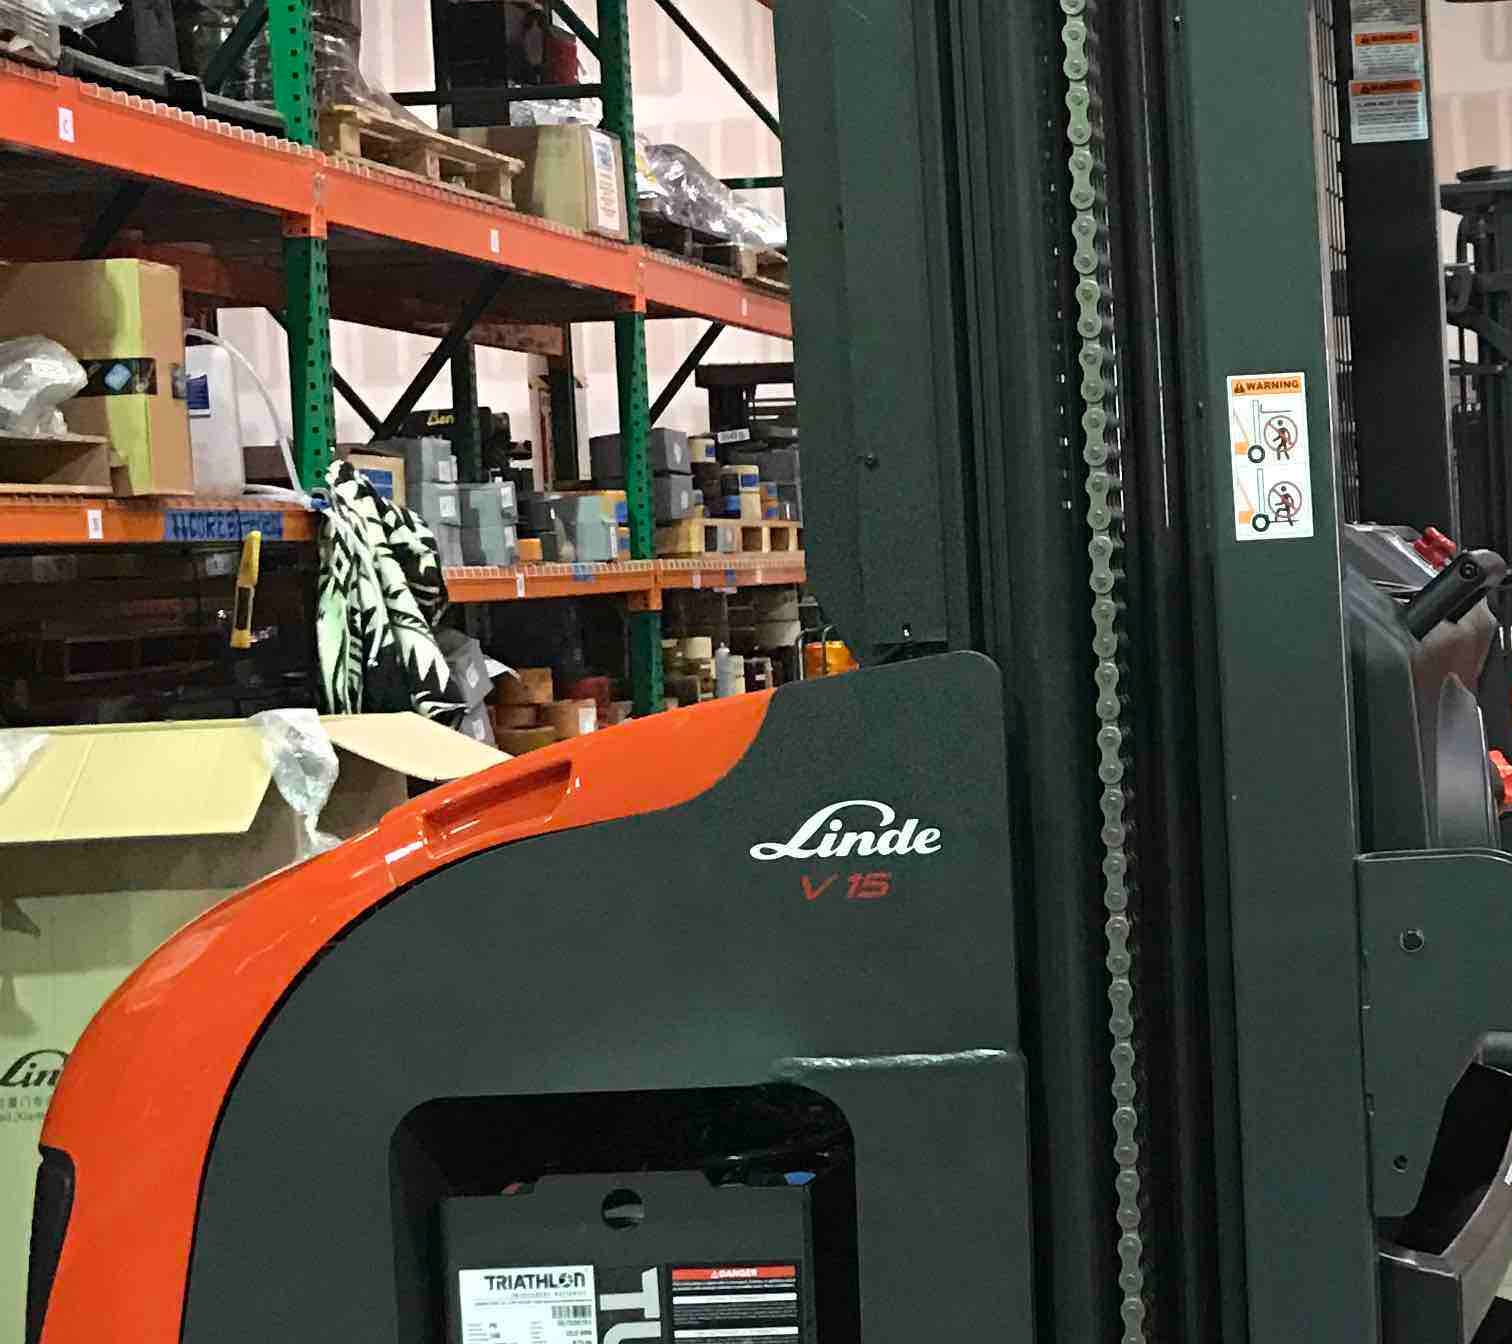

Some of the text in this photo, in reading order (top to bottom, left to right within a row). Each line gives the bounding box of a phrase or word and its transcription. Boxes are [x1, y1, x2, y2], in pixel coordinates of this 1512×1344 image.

[1246, 380, 1300, 391] WARNING
[749, 799, 942, 860] Linde
[800, 871, 892, 900] V 15
[0, 1049, 66, 1088] Lin
[484, 1272, 586, 1291] TRIATHLON
